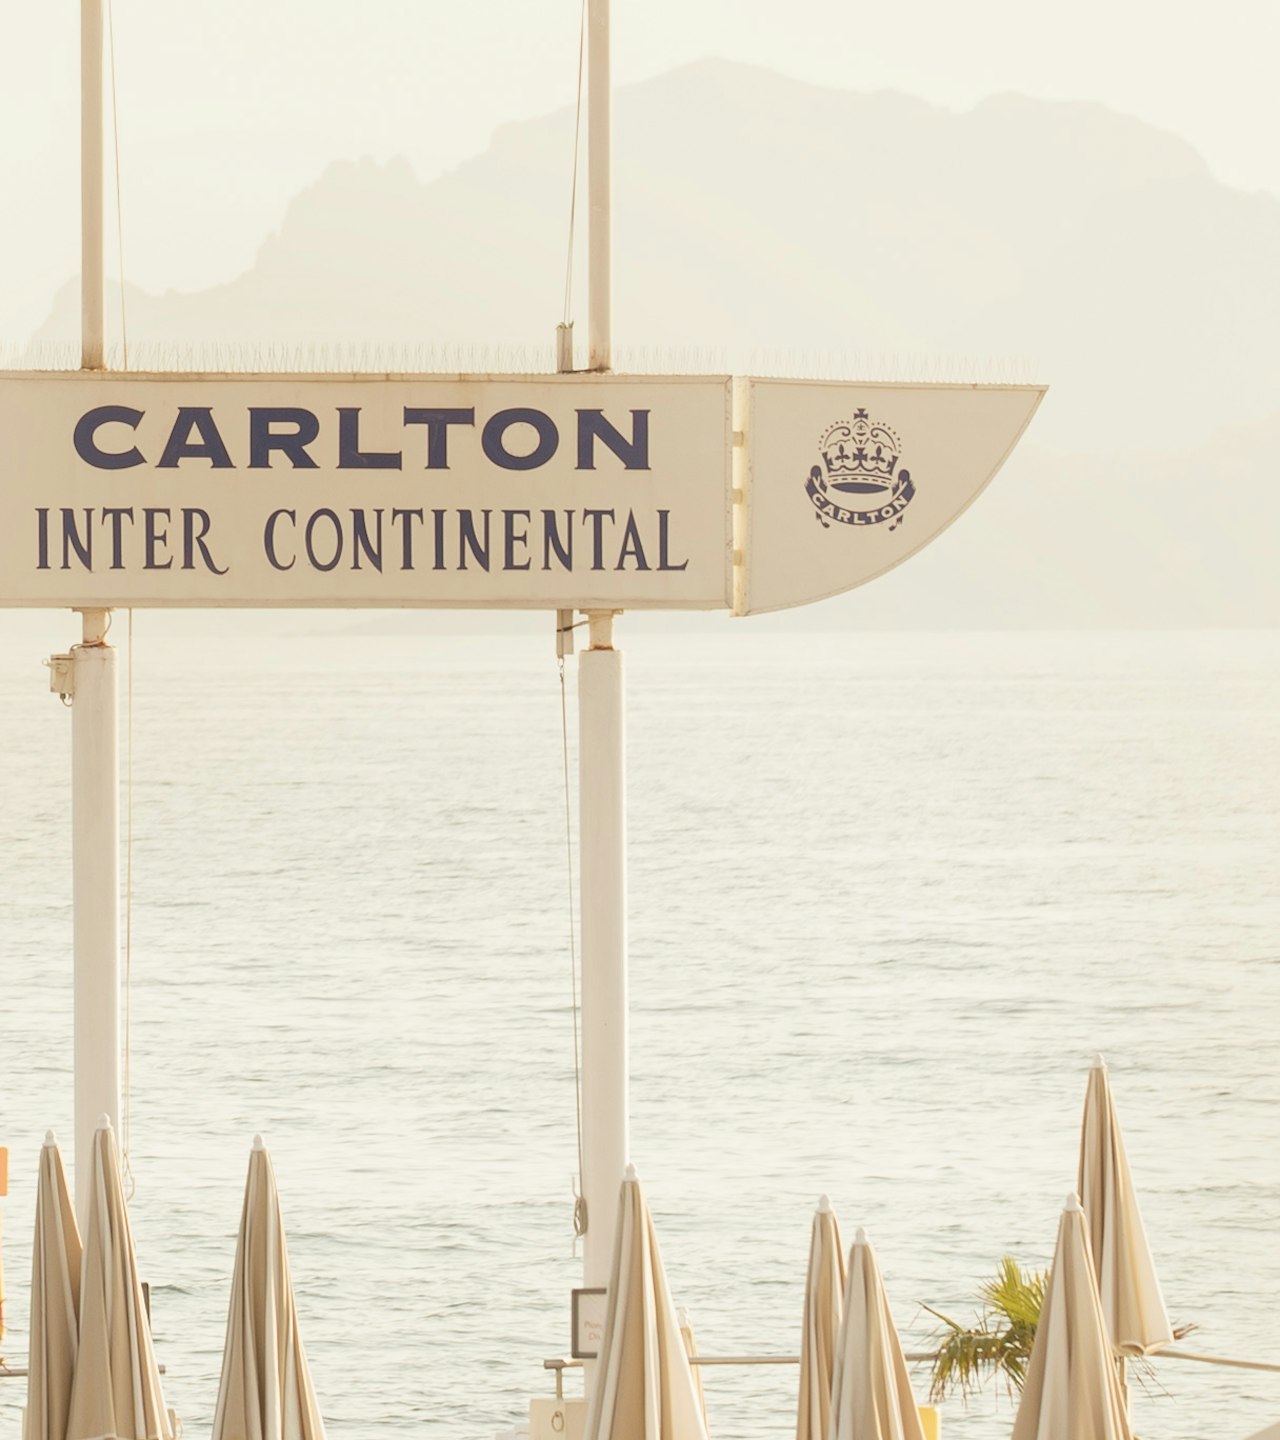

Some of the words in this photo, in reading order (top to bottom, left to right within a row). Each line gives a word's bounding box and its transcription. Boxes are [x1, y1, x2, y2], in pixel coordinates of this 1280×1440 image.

[73, 405, 651, 471] CARLTON
[35, 507, 229, 575] INTER
[264, 508, 688, 573] CONTINENTAL
[811, 493, 909, 525] CARLTON
